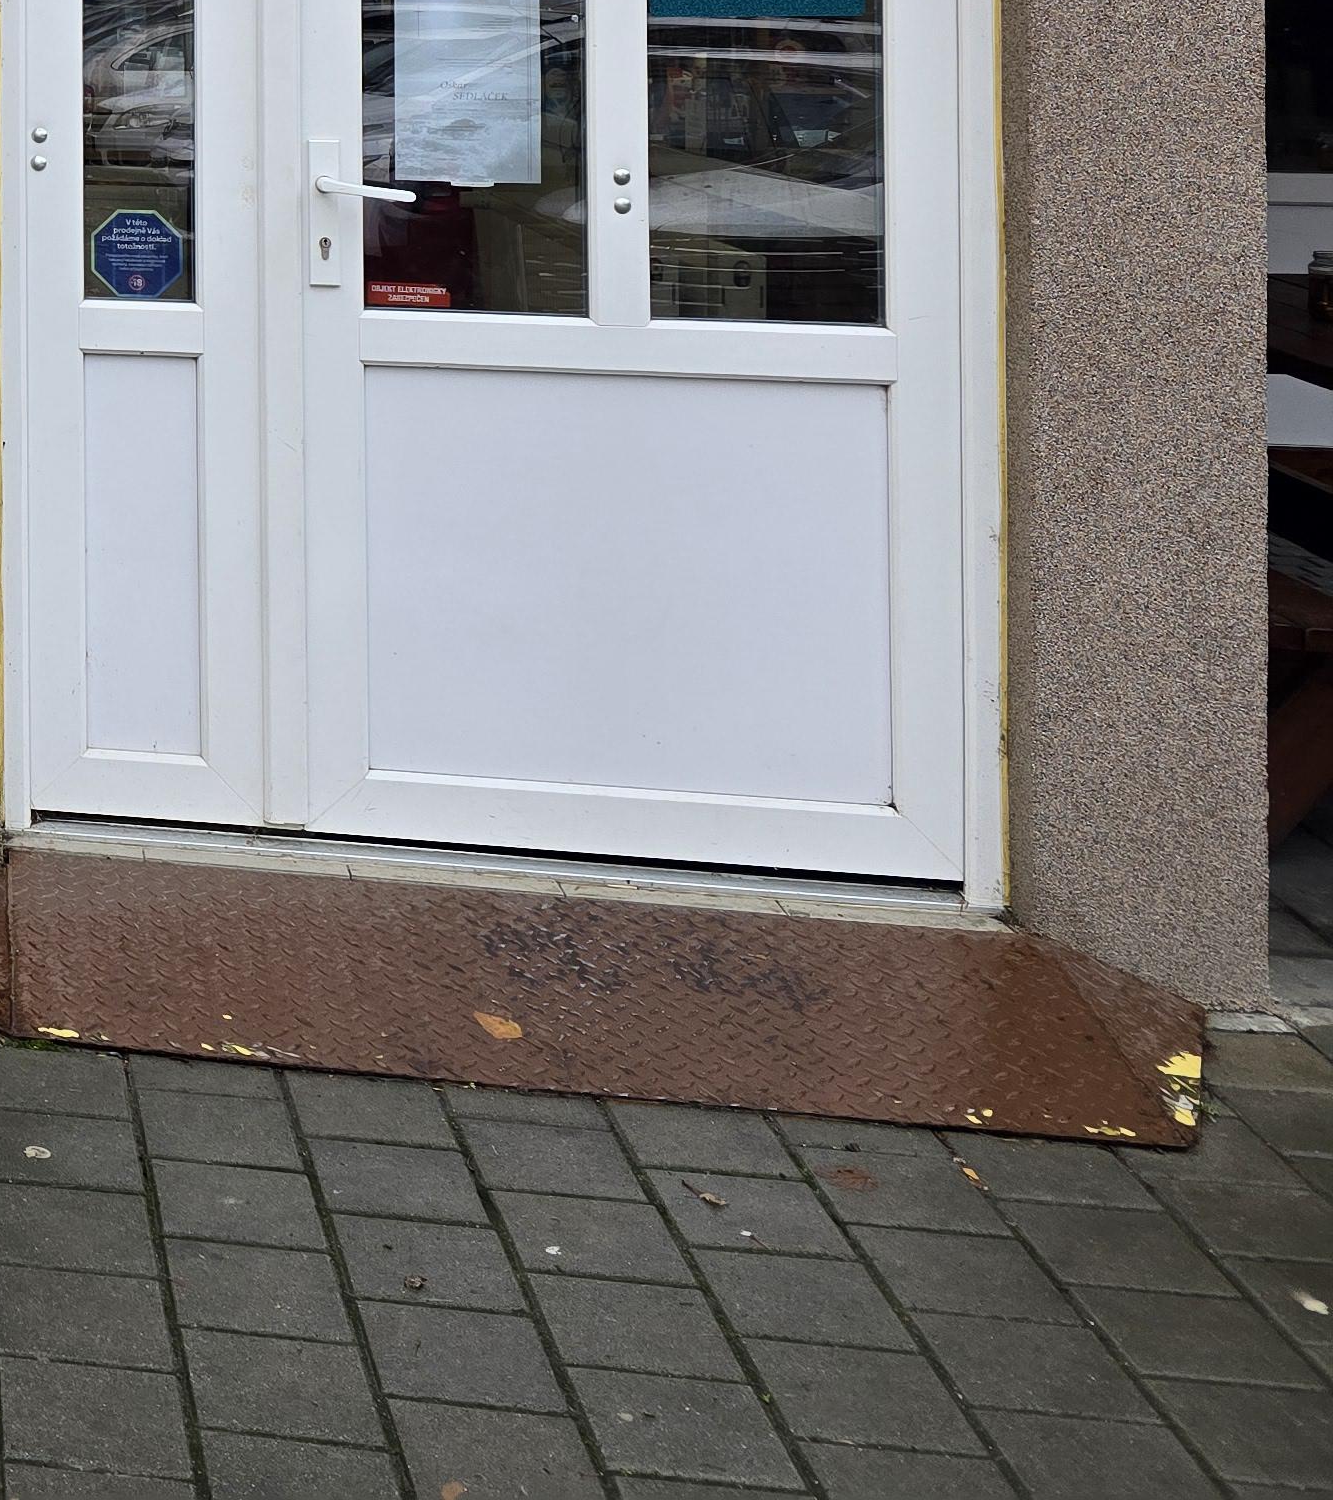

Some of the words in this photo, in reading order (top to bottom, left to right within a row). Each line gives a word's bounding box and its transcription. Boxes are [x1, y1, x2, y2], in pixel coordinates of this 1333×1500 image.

[132, 219, 148, 227] této
[113, 227, 146, 236] prodejně
[101, 234, 140, 243] požádáme
[397, 286, 447, 295] ELEKTRONICKY
